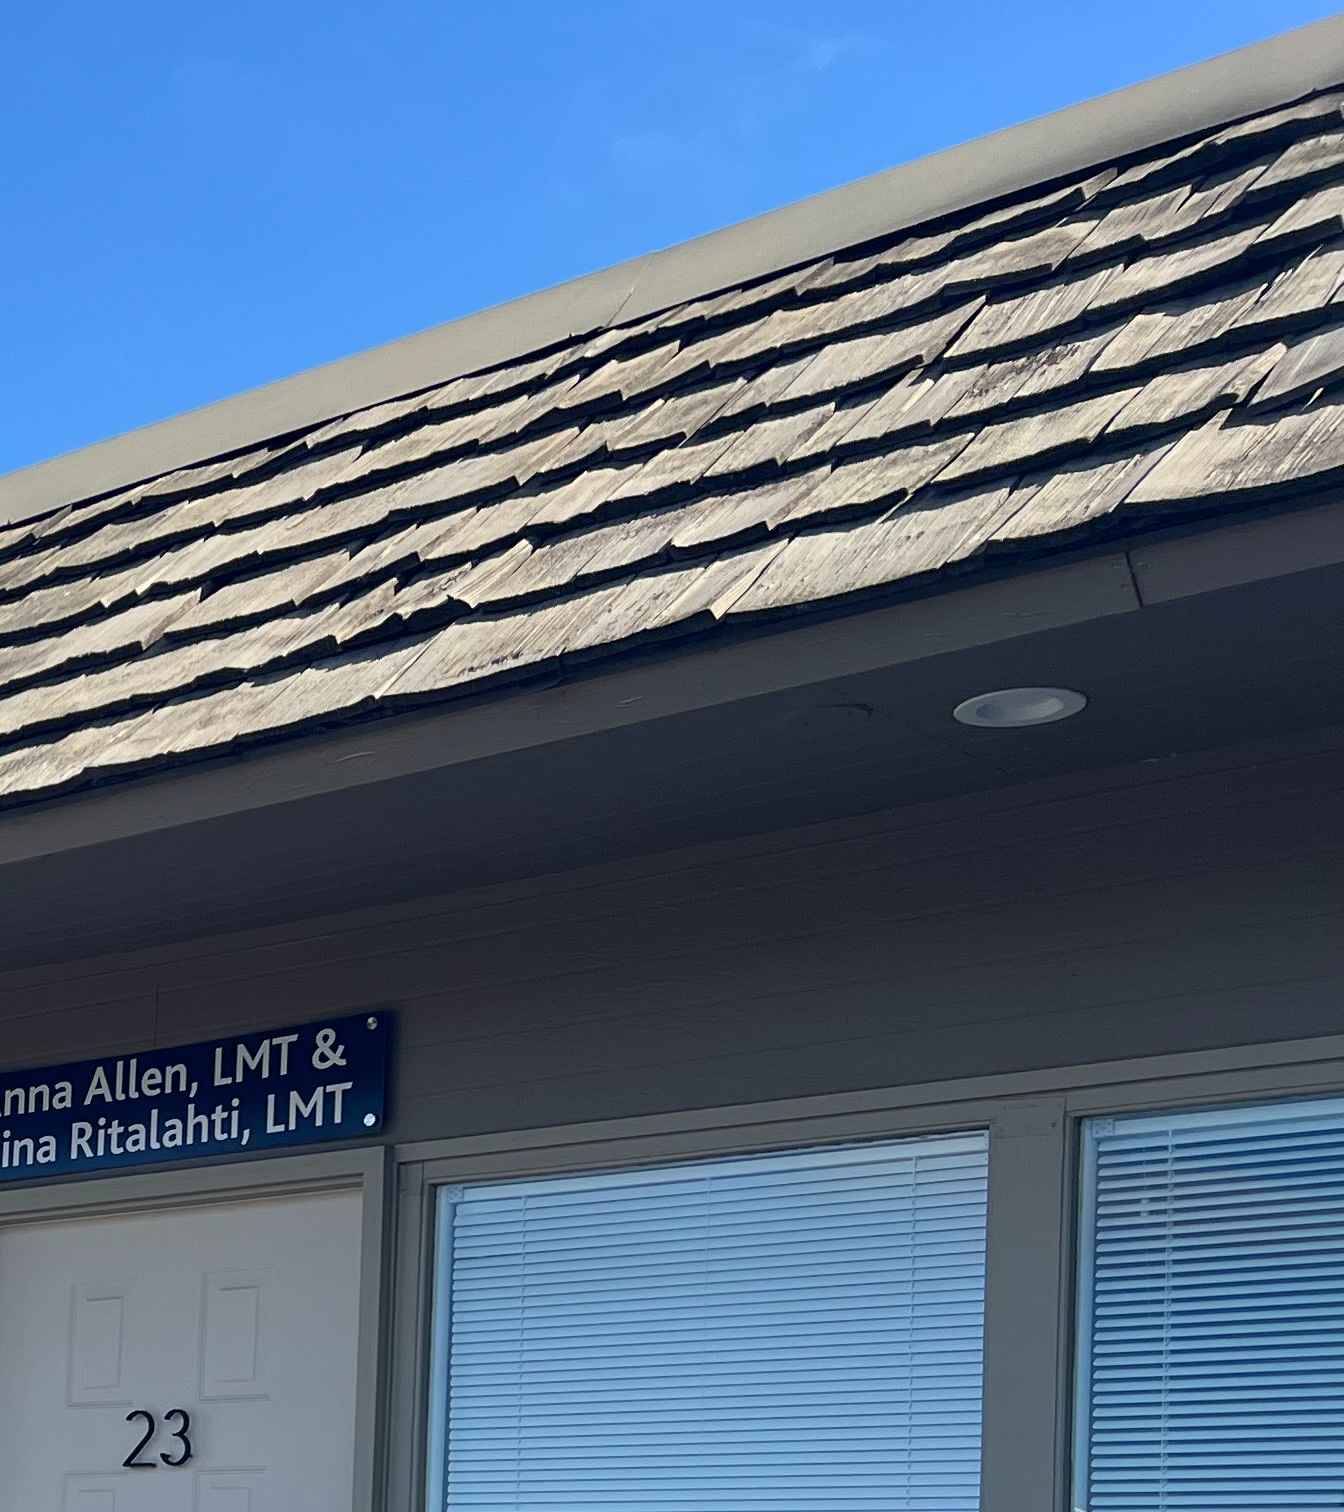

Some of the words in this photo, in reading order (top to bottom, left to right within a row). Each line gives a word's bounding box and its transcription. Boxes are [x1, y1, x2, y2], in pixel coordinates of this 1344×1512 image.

[83, 1058, 199, 1106] Allen,
[213, 1033, 300, 1087] LMT
[311, 1028, 347, 1070] &
[70, 1097, 251, 1160] Ritalahti,
[265, 1080, 354, 1134] LMT
[122, 1408, 193, 1468] 23
